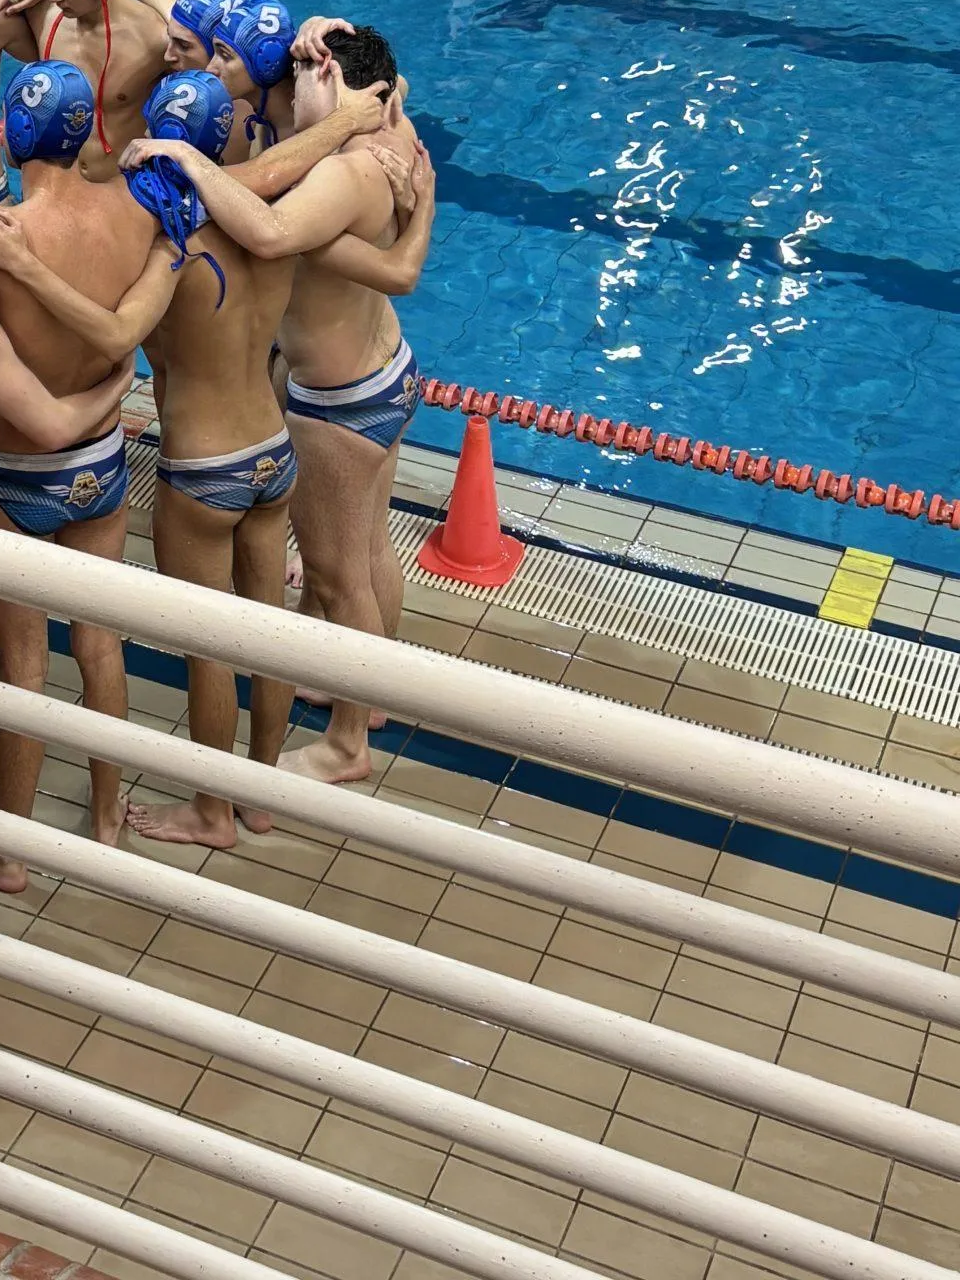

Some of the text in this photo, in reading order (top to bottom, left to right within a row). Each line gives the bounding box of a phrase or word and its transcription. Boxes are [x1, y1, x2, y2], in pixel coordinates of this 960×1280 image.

[257, 5, 280, 34] 5
[21, 73, 52, 108] 3
[165, 83, 198, 121] 2
